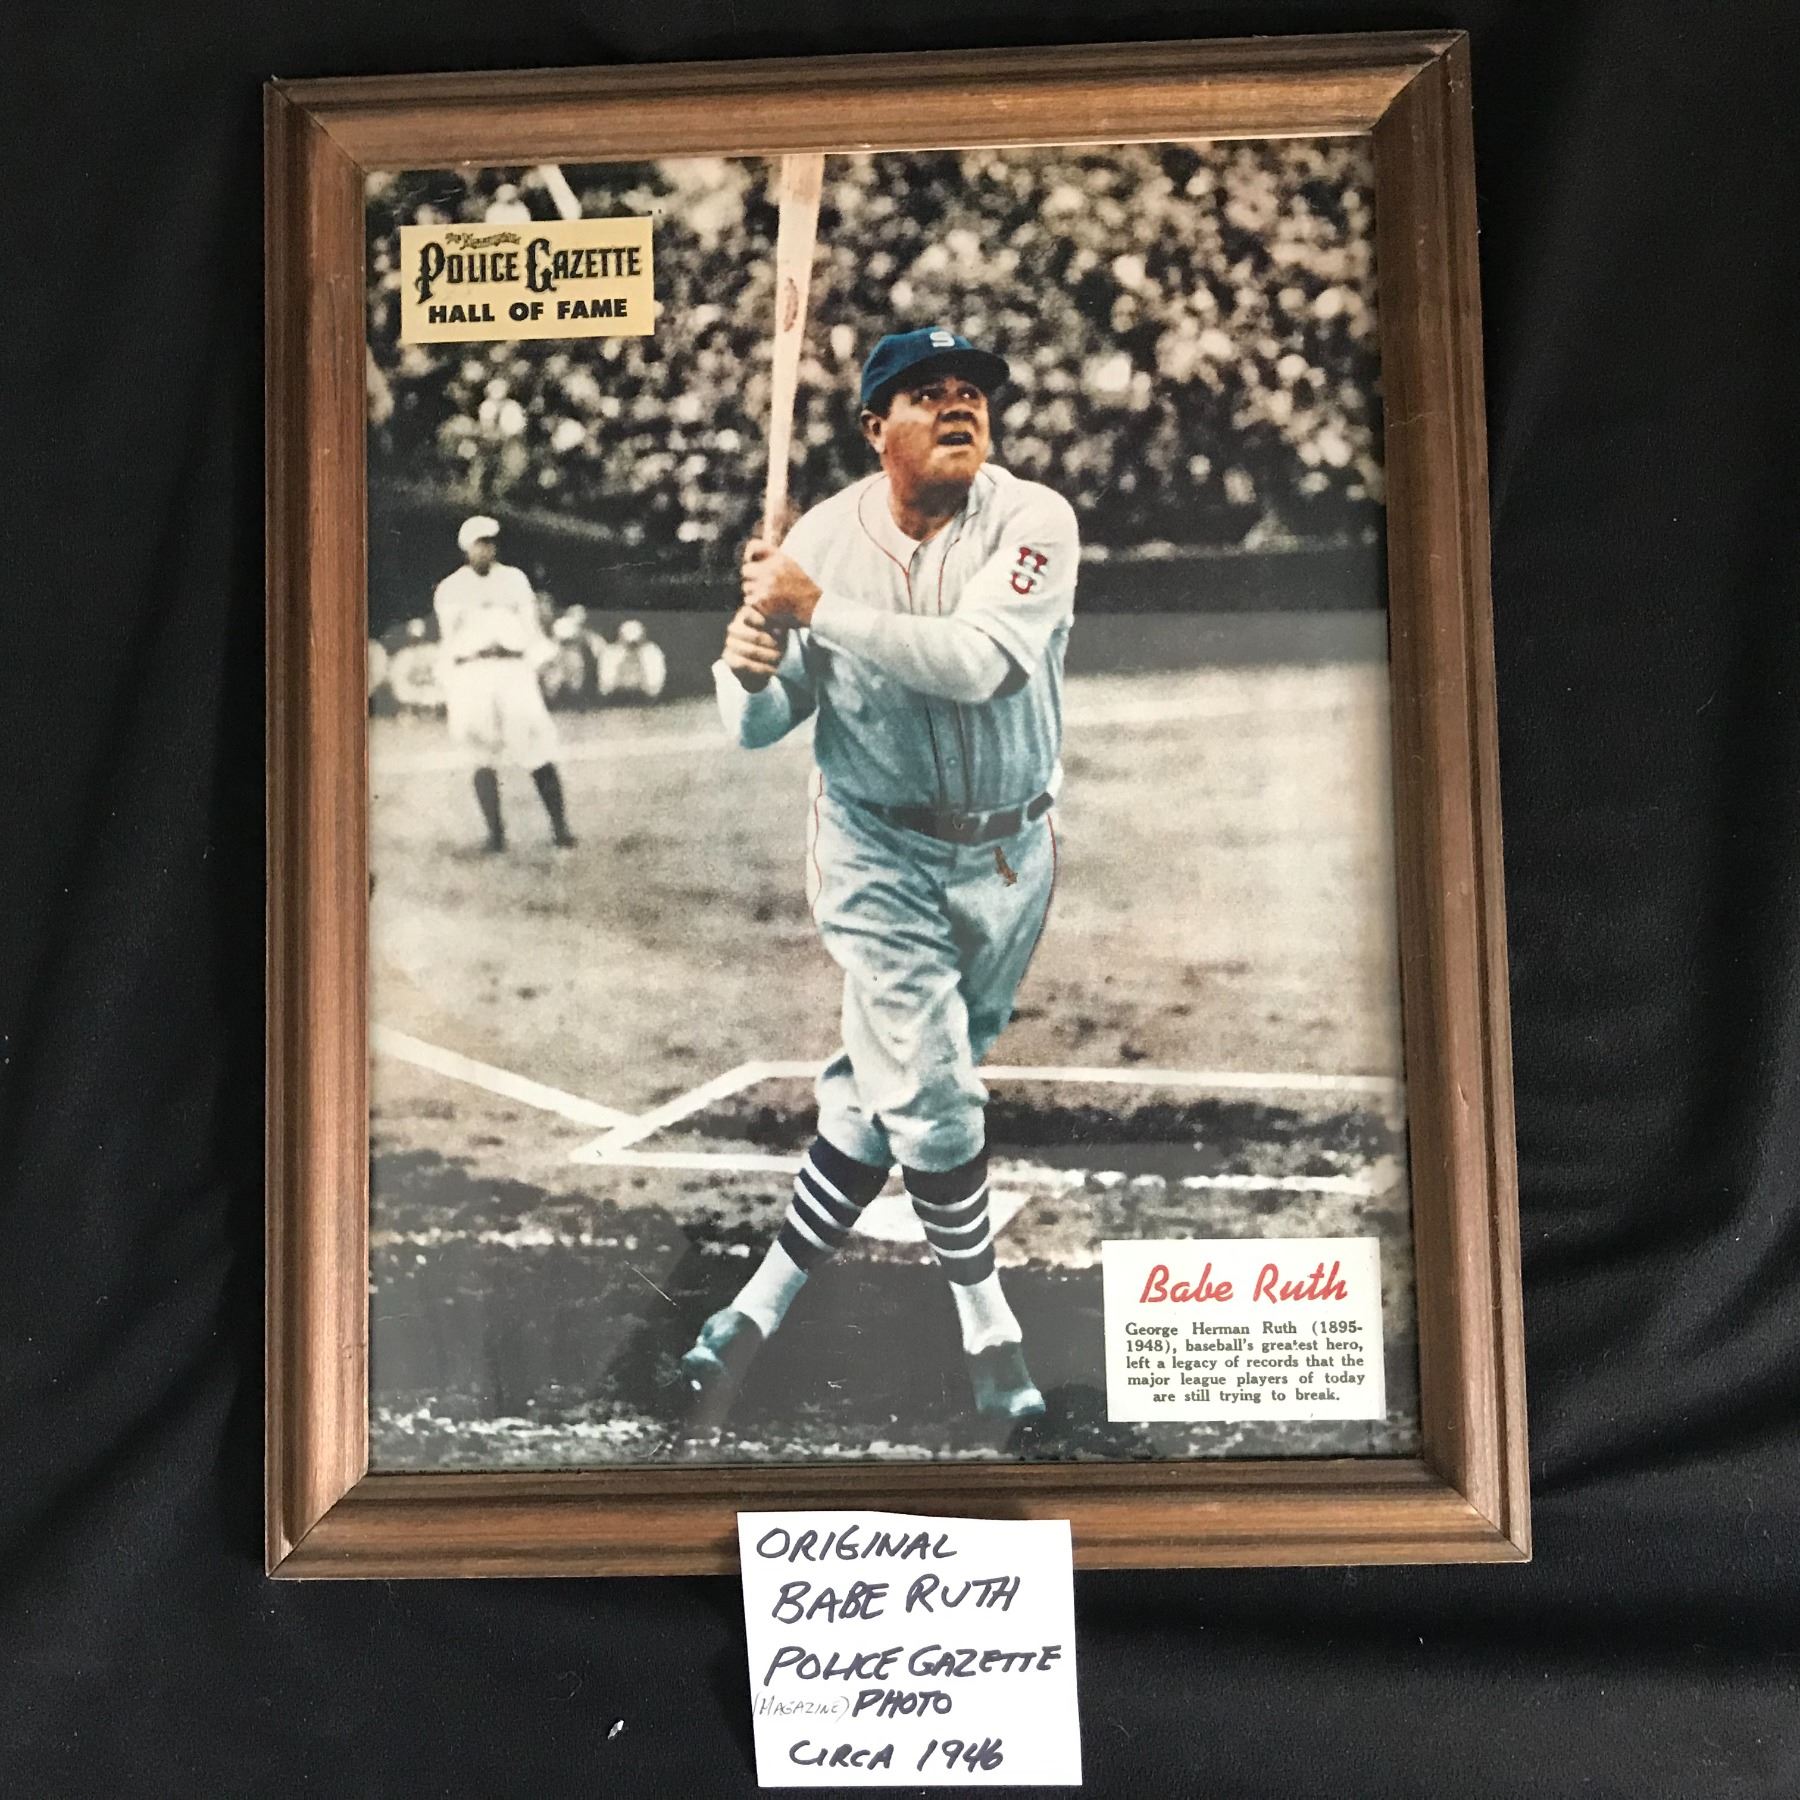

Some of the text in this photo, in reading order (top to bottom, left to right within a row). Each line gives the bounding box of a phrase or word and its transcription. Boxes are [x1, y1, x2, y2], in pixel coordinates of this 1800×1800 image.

[429, 299, 627, 324] HALL OF FAME
[1139, 1261, 1347, 1304] Babe Ruth
[1125, 1320, 1362, 1338] George Herman Ruth (1895-
[1127, 1339, 1176, 1354] 1948),
[1186, 1338, 1253, 1351] baseball's
[1326, 1337, 1363, 1352] hero,
[1127, 1354, 1363, 1370] left a legacy of records that the
[1128, 1371, 1365, 1387] major league players of today
[1153, 1388, 1339, 1403] are still trying to break.
[757, 1525, 957, 1562] ORIGINAL
[772, 1574, 1020, 1624] BABE RUTH
[852, 1689, 952, 1718] PHOTO
[789, 1738, 1003, 1772] CIRCA 1946
